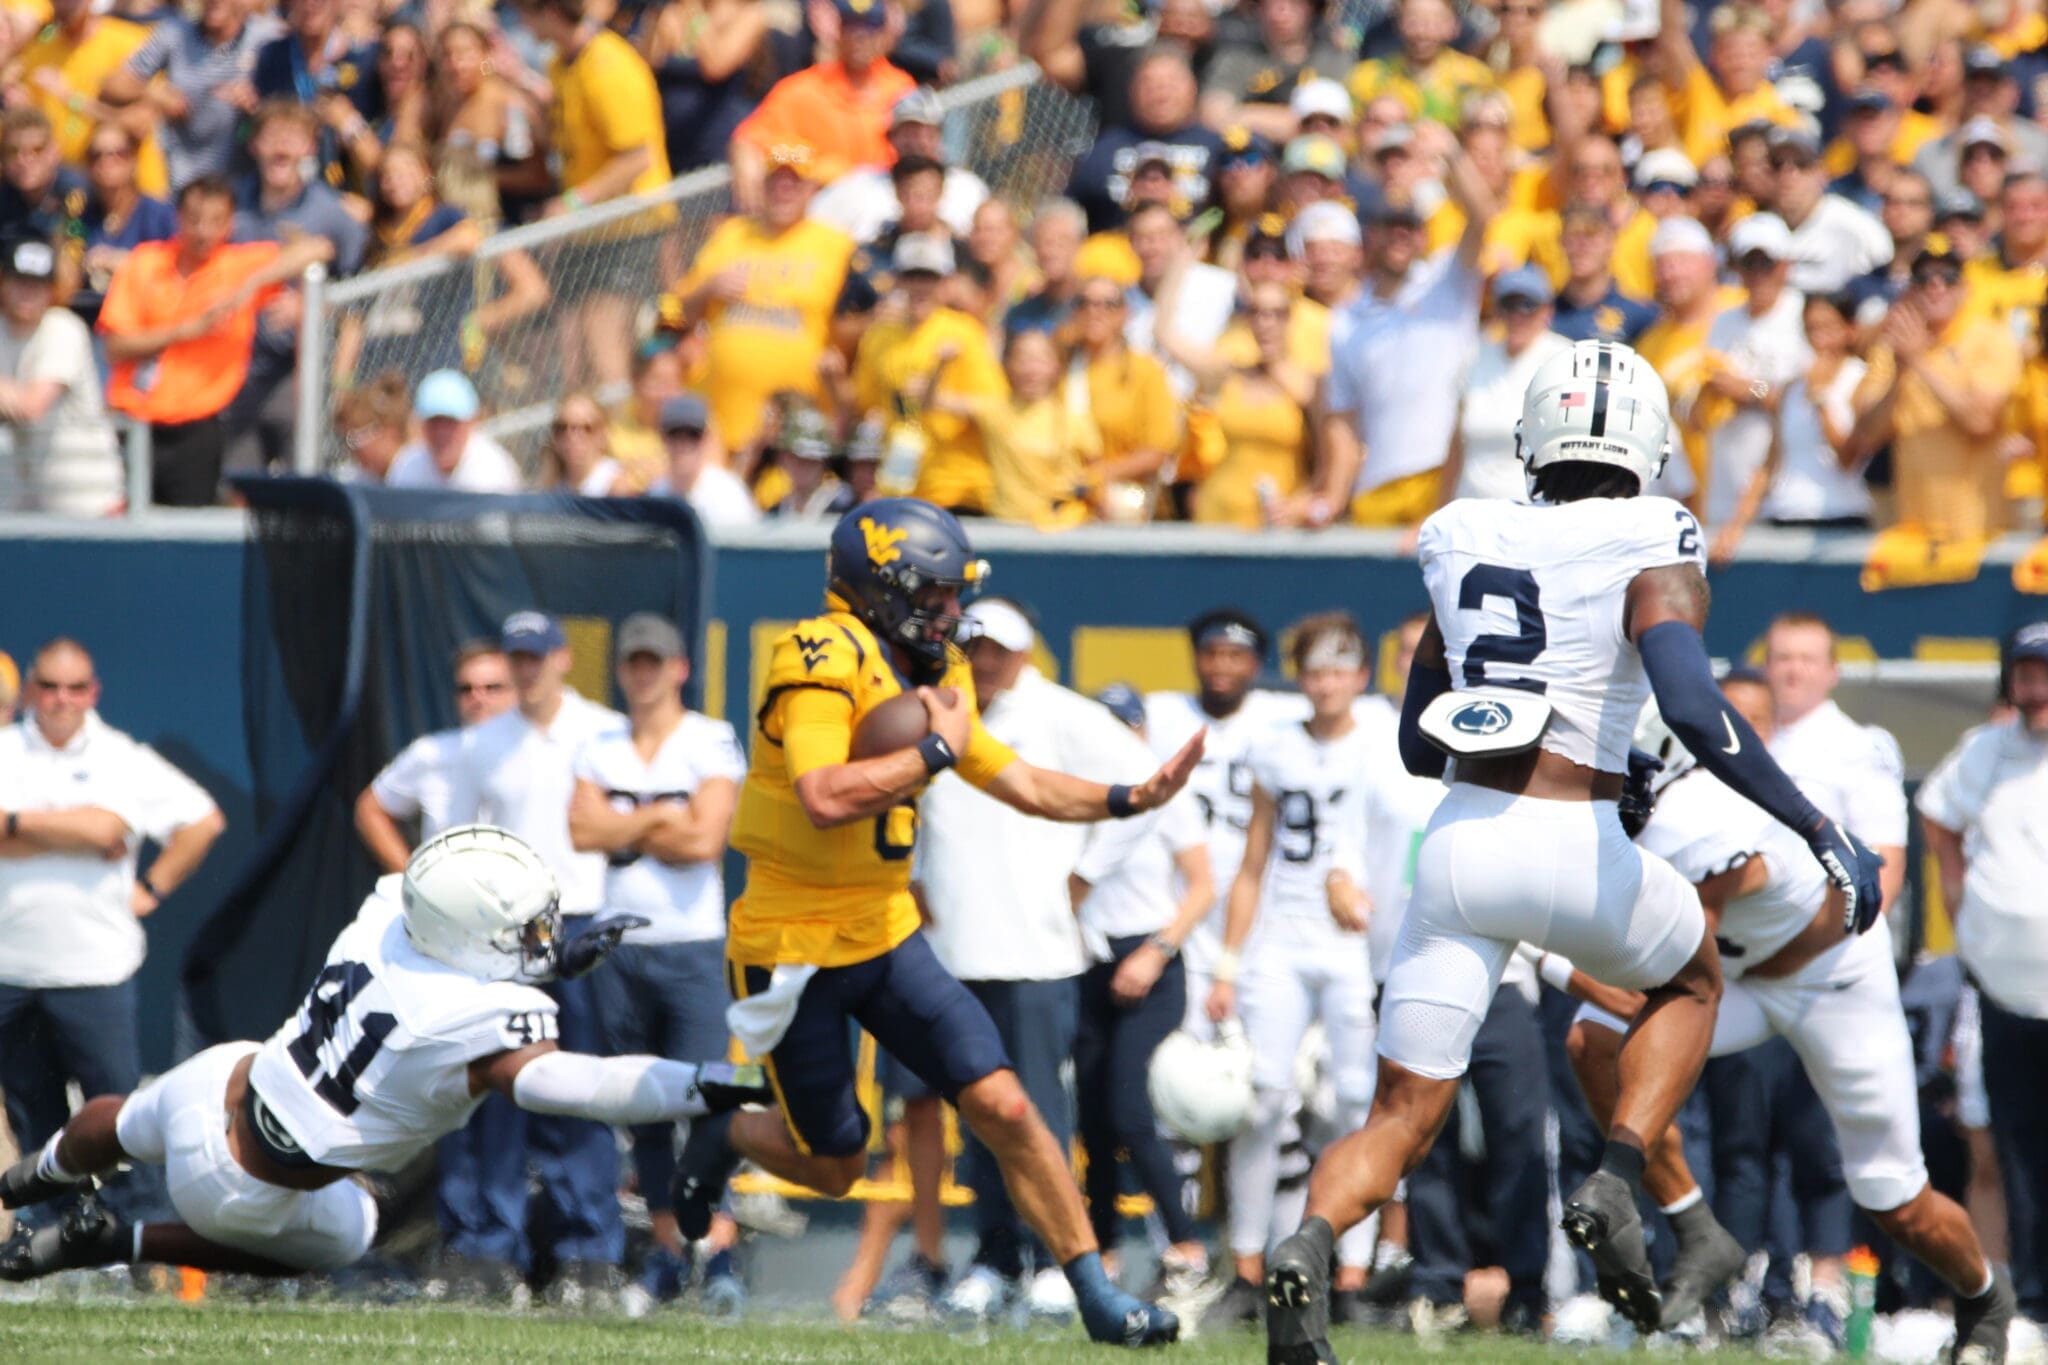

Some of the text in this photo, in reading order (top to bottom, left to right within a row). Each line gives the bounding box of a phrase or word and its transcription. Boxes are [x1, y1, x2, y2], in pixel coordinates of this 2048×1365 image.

[1560, 440, 1629, 456] NITTANY LIONS
[1675, 511, 1698, 556] 2
[1458, 562, 1547, 696] 2
[287, 959, 398, 1118] 41
[506, 1011, 547, 1045] 41
